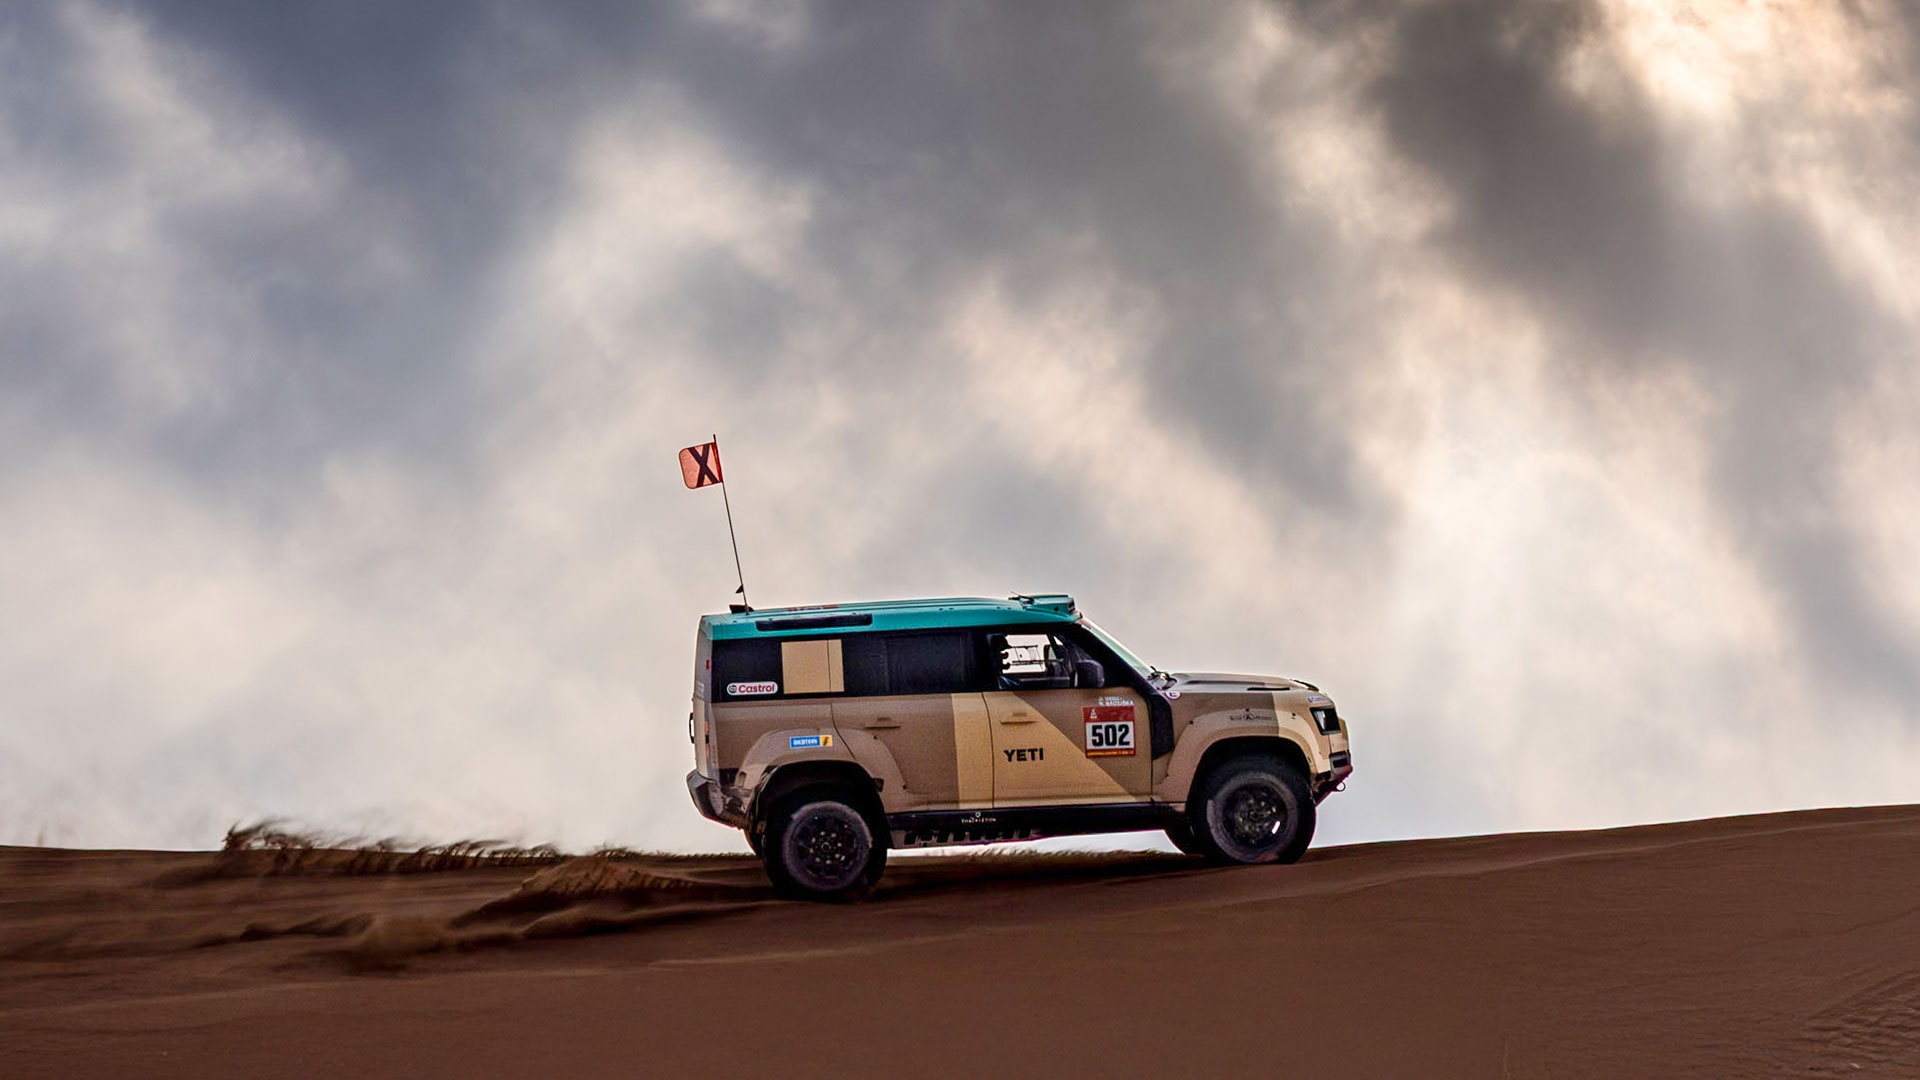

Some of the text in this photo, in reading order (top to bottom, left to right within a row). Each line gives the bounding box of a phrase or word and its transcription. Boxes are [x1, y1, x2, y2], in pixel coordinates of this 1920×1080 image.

[739, 684, 775, 694] Castrol
[1091, 724, 1131, 747] 502
[1003, 748, 1044, 762] YETI
